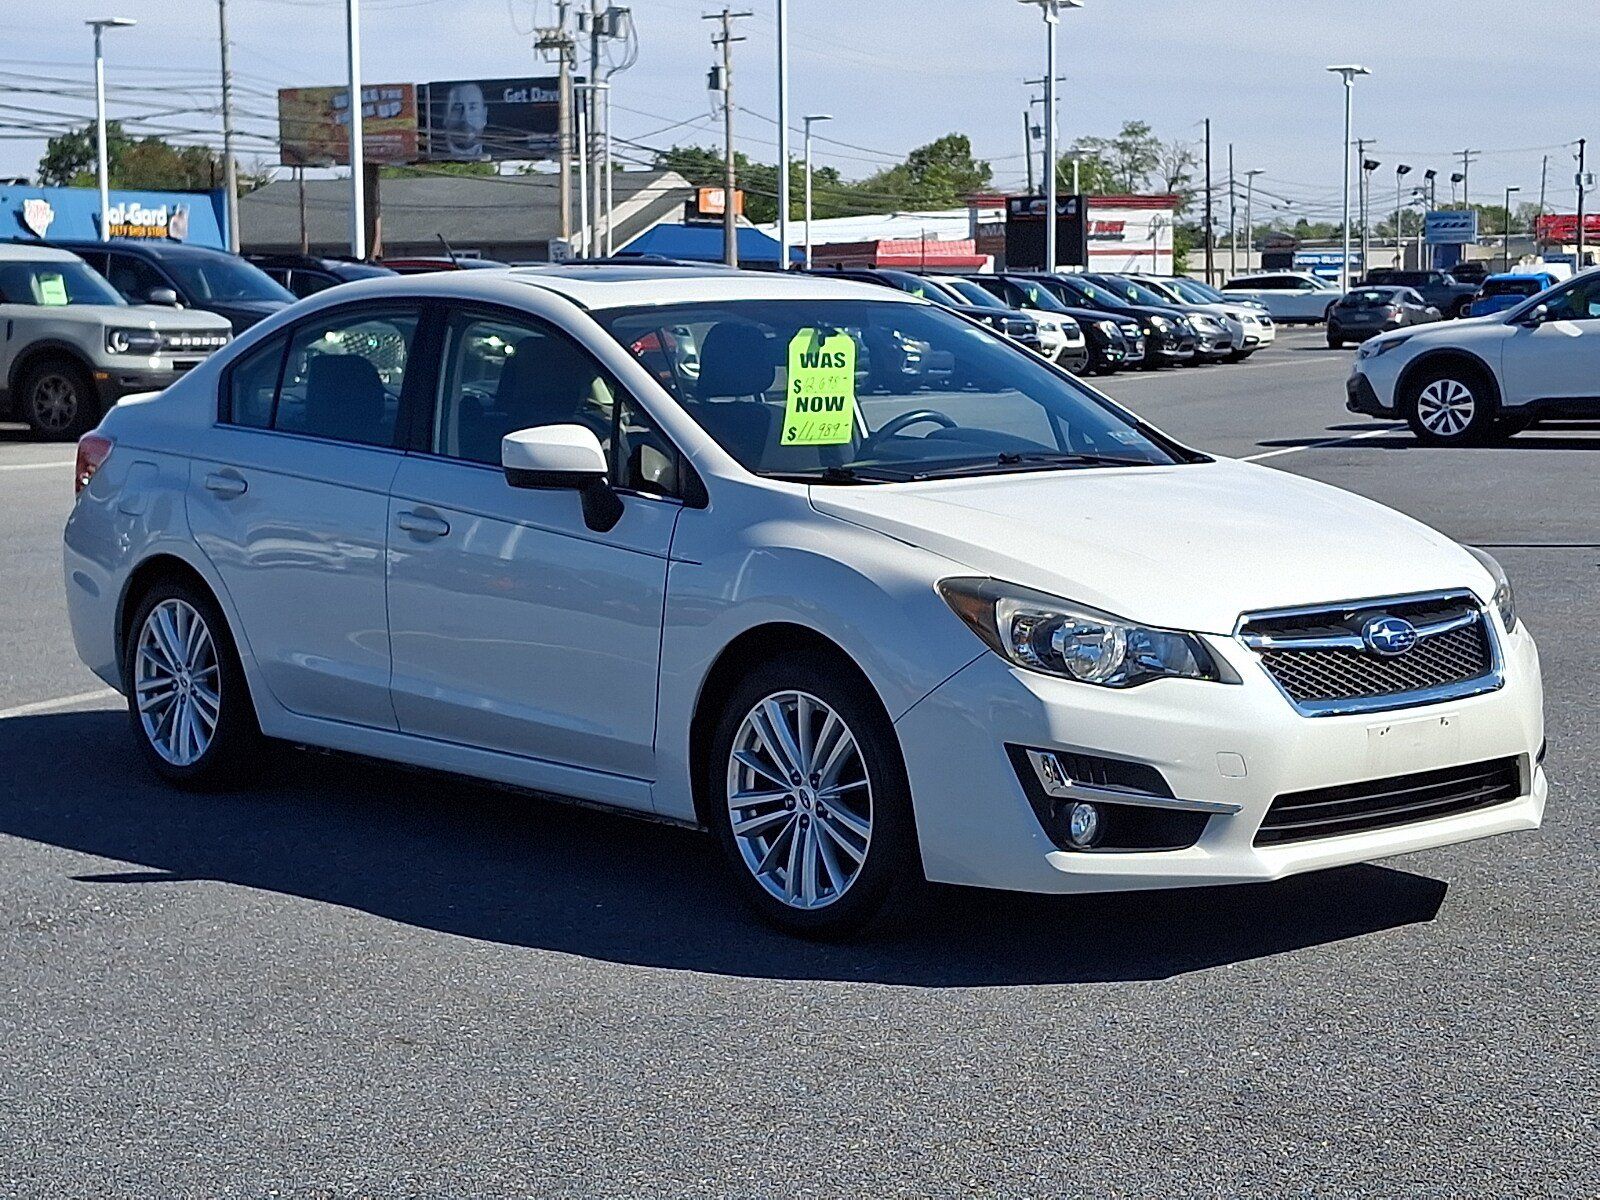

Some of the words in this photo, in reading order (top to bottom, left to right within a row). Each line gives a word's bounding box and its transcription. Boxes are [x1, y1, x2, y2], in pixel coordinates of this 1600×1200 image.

[503, 88, 529, 103] Get
[104, 202, 168, 226] al-Gard
[800, 352, 845, 368] WAS
[796, 396, 845, 412] NOW
